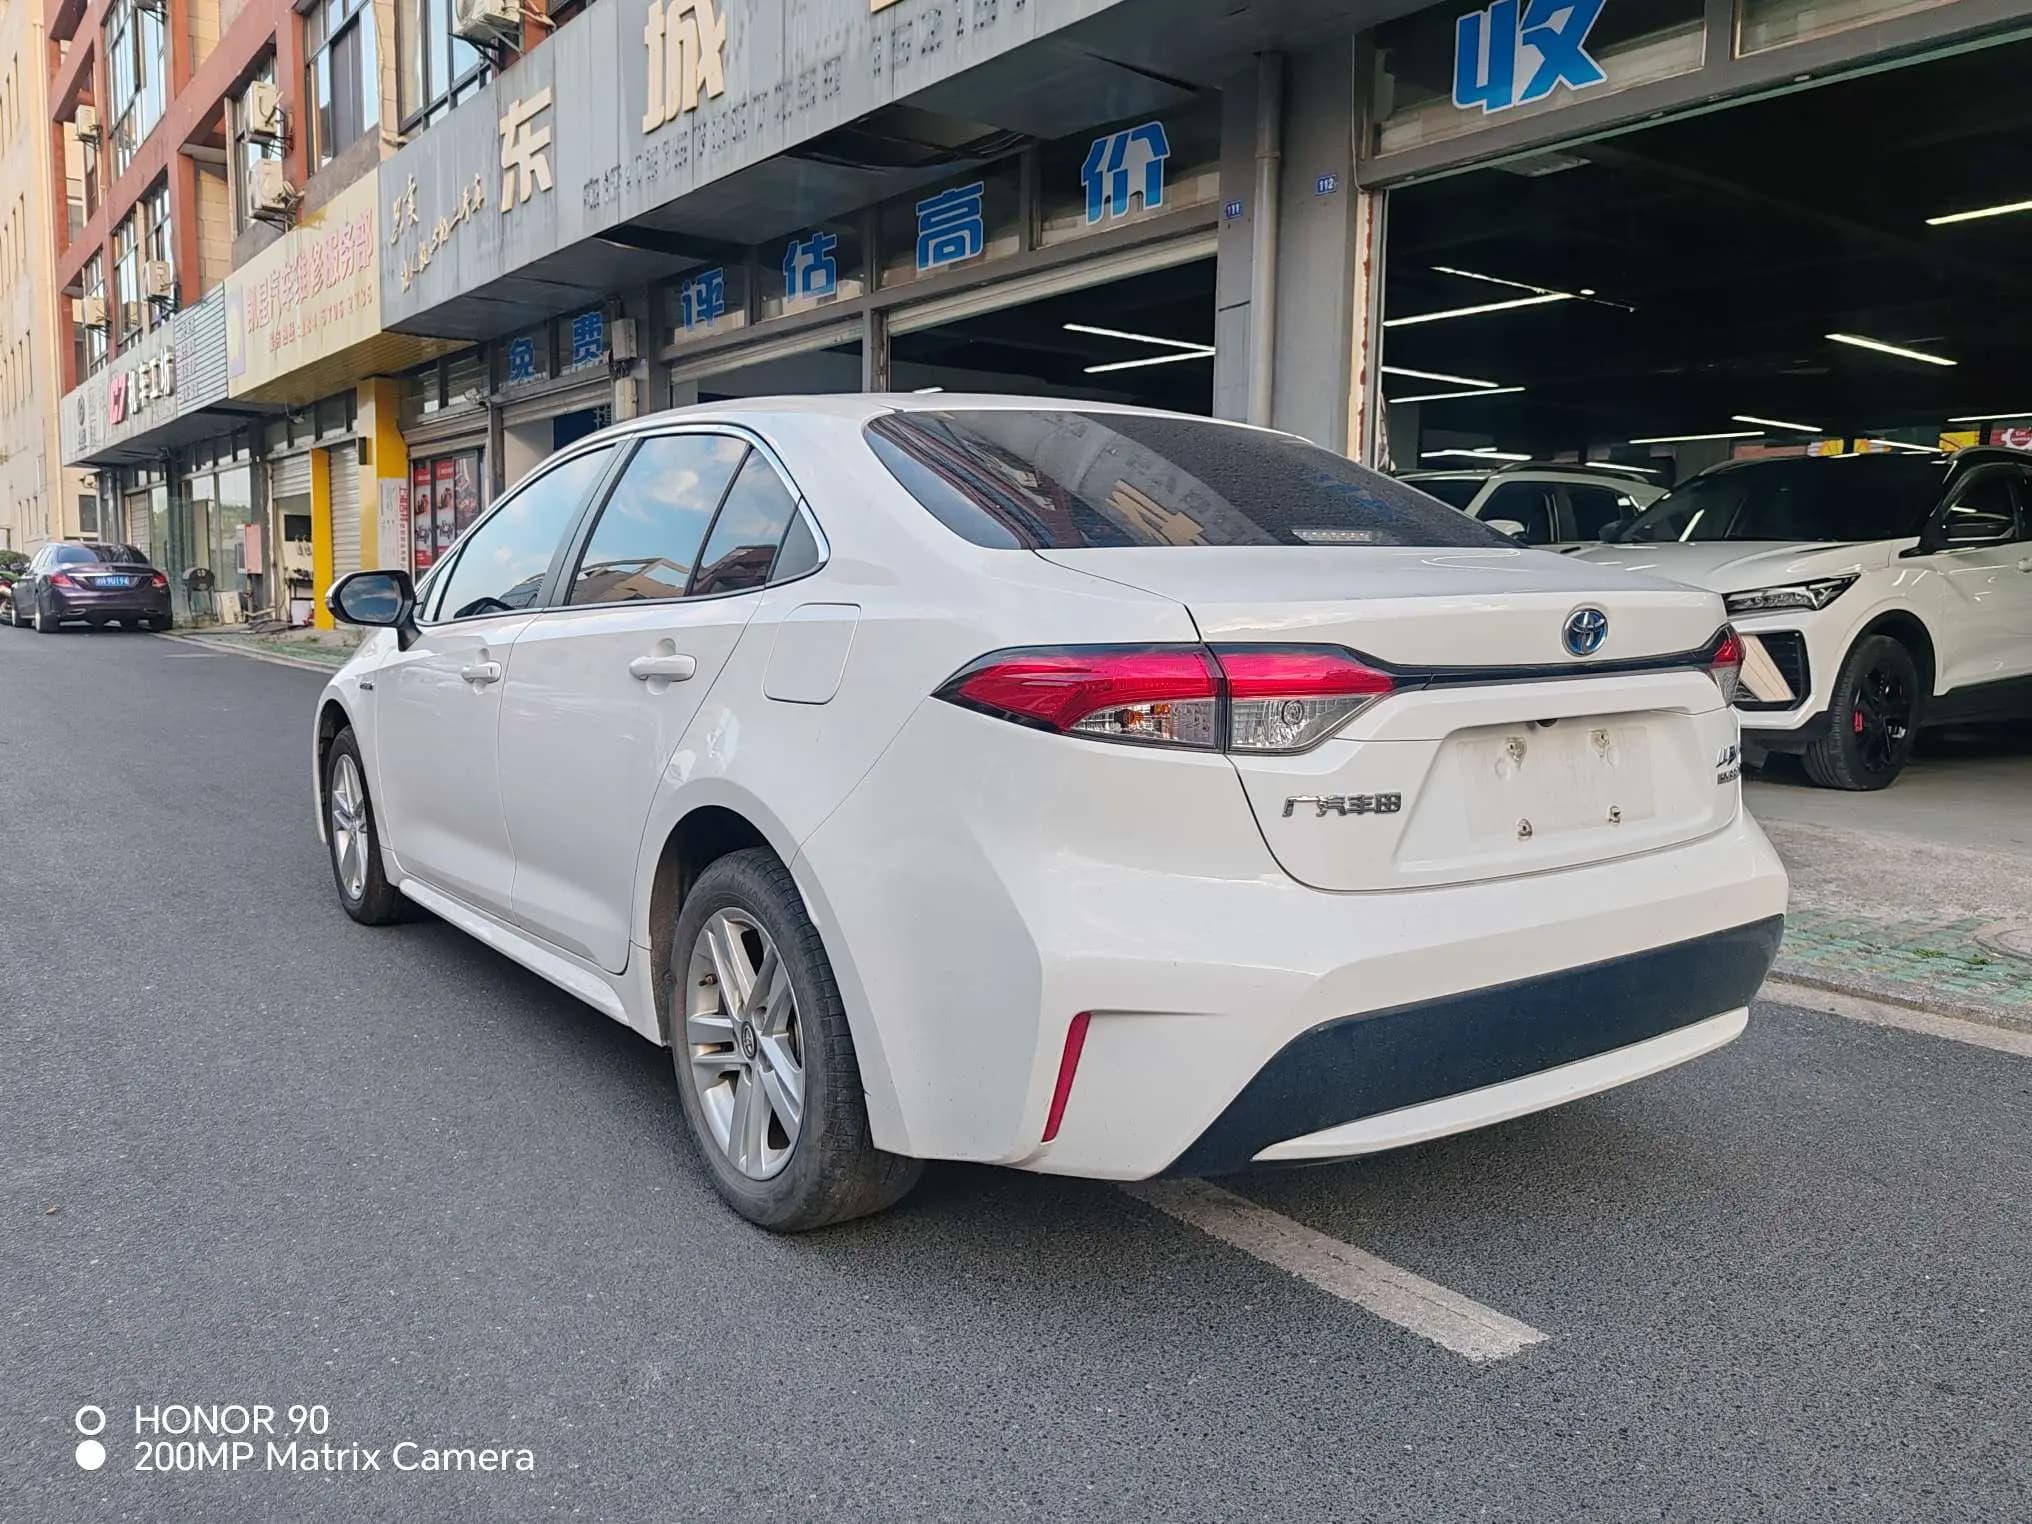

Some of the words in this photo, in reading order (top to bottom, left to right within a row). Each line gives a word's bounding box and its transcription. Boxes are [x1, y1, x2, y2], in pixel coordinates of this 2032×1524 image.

[680, 266, 726, 332] 评
[782, 231, 838, 303] 估
[915, 181, 985, 272] 高
[1081, 119, 1172, 226] 价
[1451, 0, 1609, 116] 收
[1318, 177, 1336, 194] 112
[1281, 791, 1402, 818] 广汽丰田
